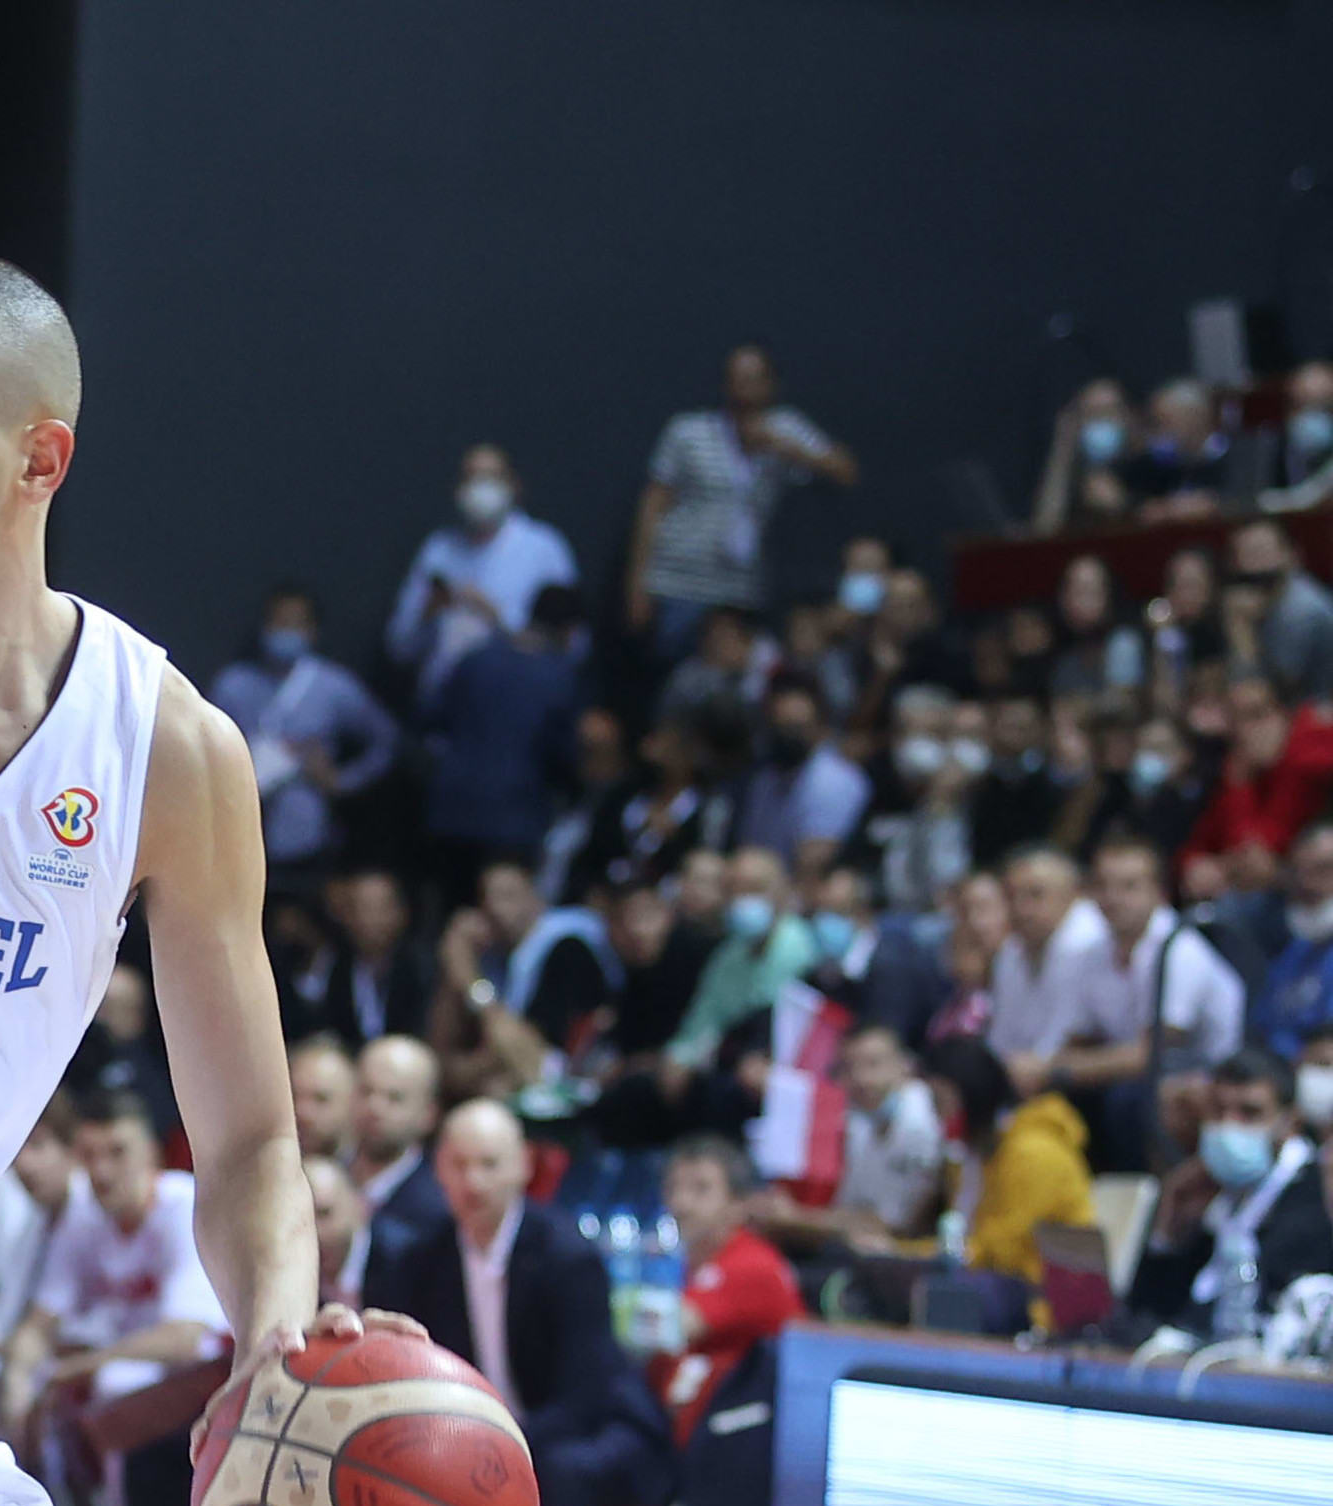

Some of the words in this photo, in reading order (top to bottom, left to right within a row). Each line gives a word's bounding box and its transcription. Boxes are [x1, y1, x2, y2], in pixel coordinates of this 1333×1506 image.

[28, 861, 66, 876] WORLD
[68, 868, 90, 880] CUP
[27, 872, 86, 889] QUALIFIERS
